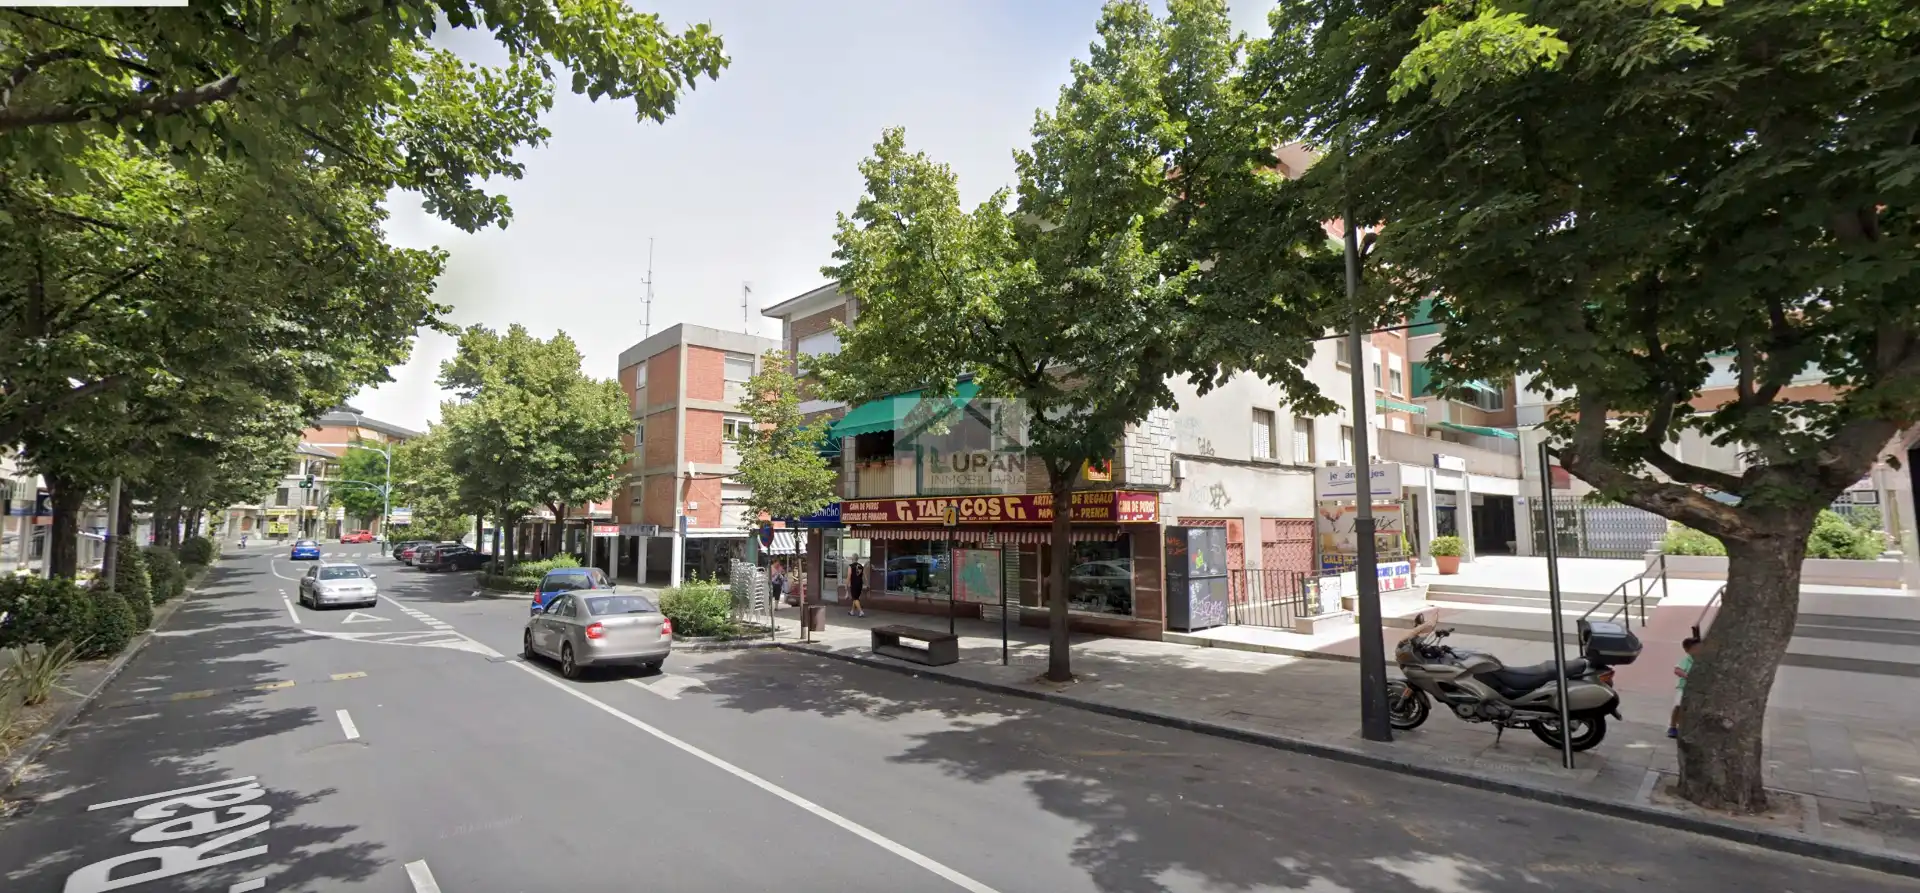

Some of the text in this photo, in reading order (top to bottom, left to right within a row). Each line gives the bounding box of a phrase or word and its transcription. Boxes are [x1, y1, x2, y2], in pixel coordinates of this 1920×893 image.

[1071, 494, 1082, 505] DE
[1083, 493, 1114, 504] REGALO
[916, 498, 1001, 517] TABACOS
[1080, 507, 1109, 519] PRENSA
[1131, 501, 1139, 513] DE
